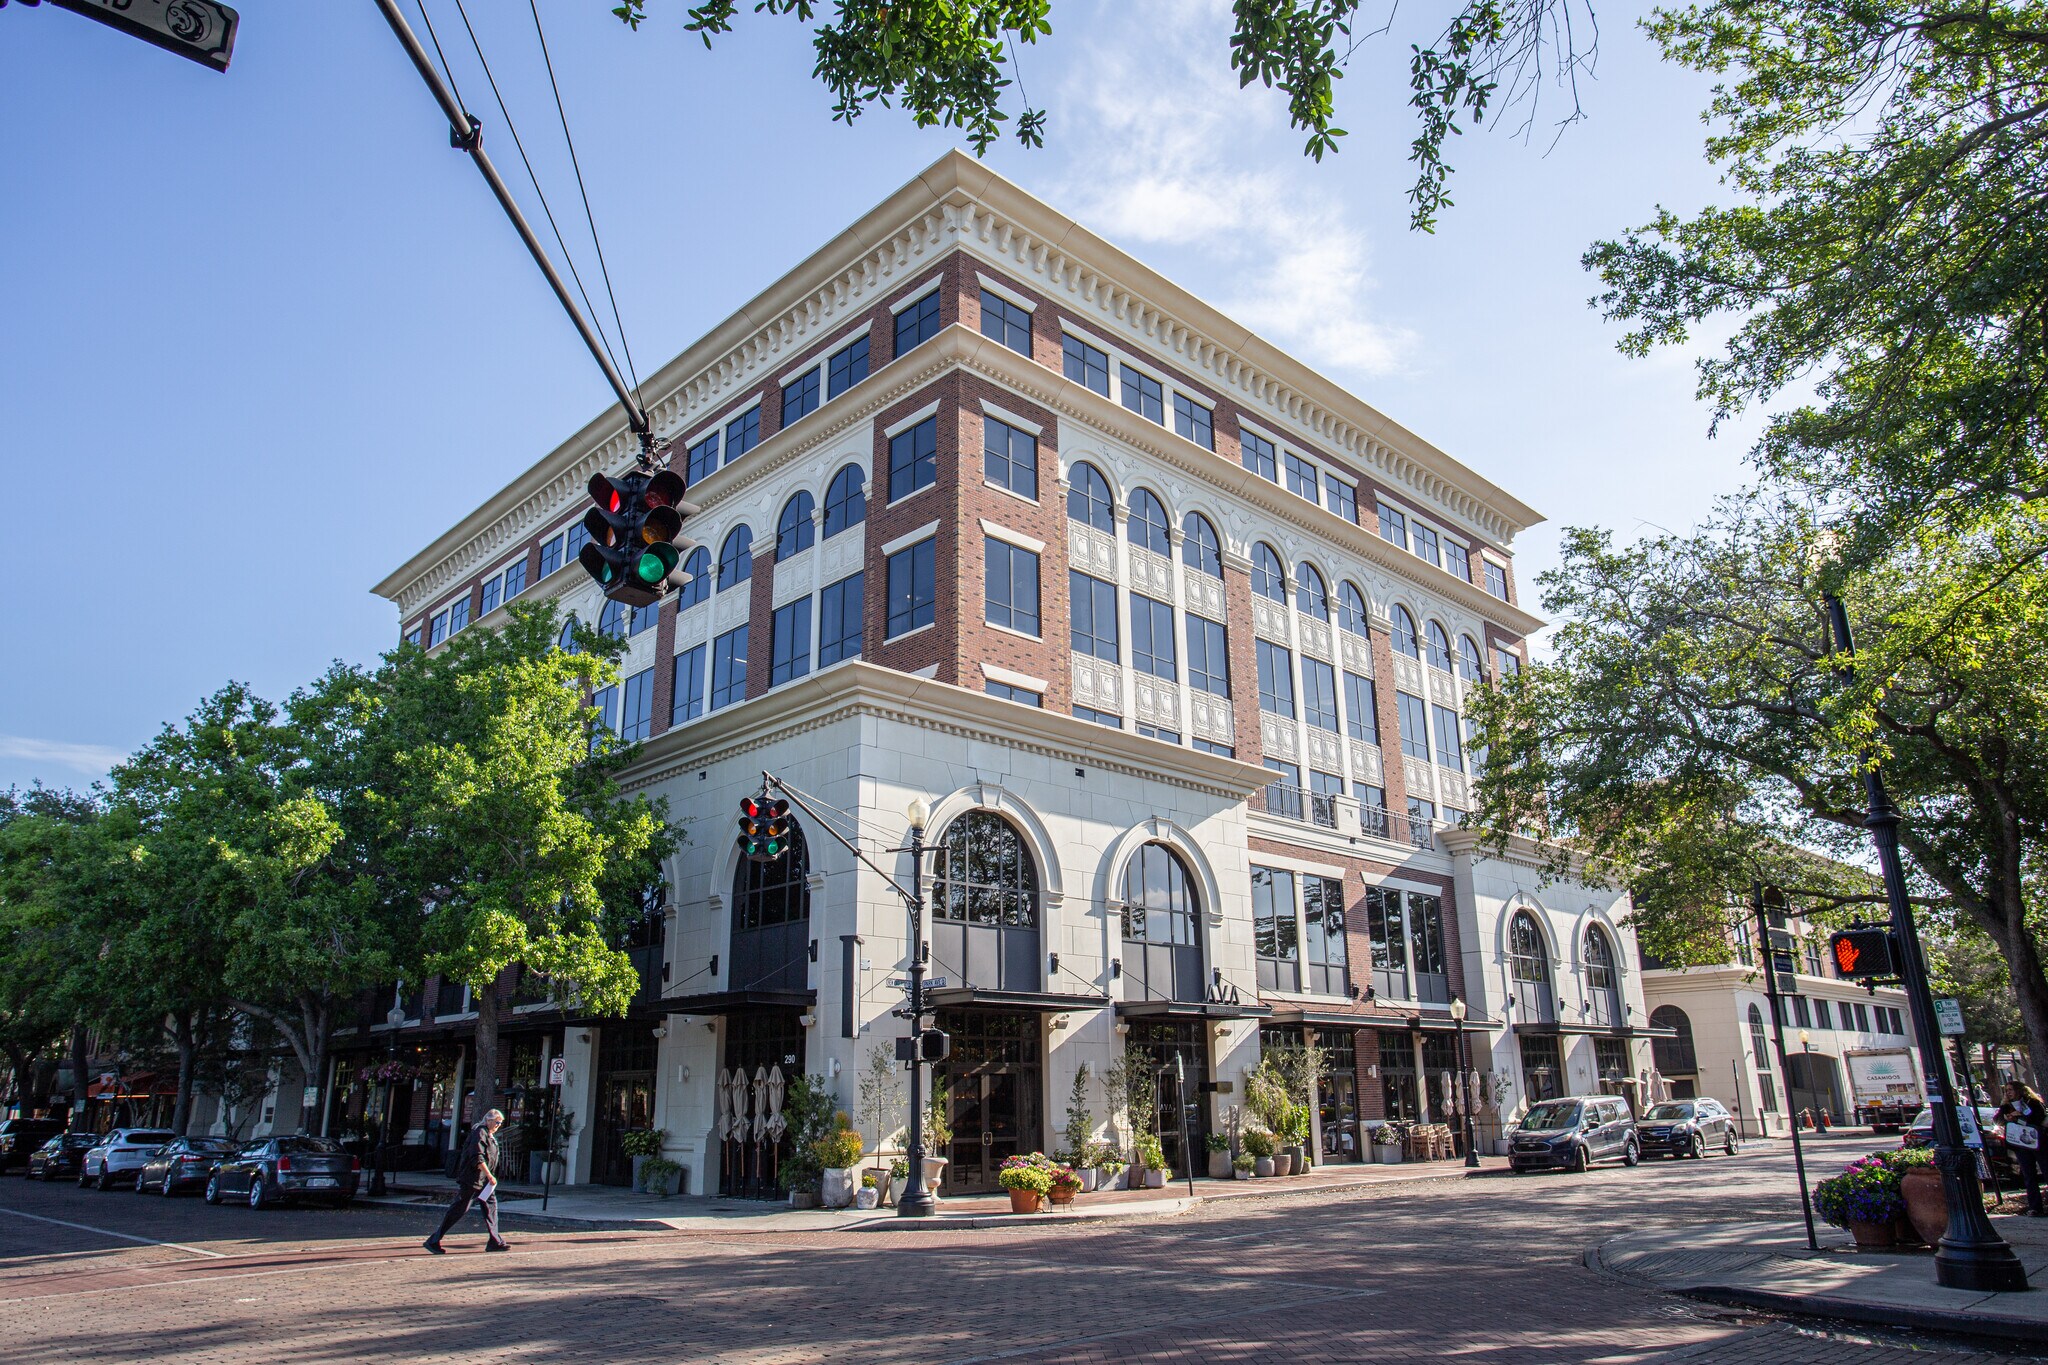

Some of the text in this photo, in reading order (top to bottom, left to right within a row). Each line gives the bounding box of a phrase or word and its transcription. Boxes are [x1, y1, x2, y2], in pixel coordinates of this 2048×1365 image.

[1206, 984, 1240, 1005] AVA
[1936, 1002, 1942, 1012] 3
[784, 1054, 796, 1064] 290
